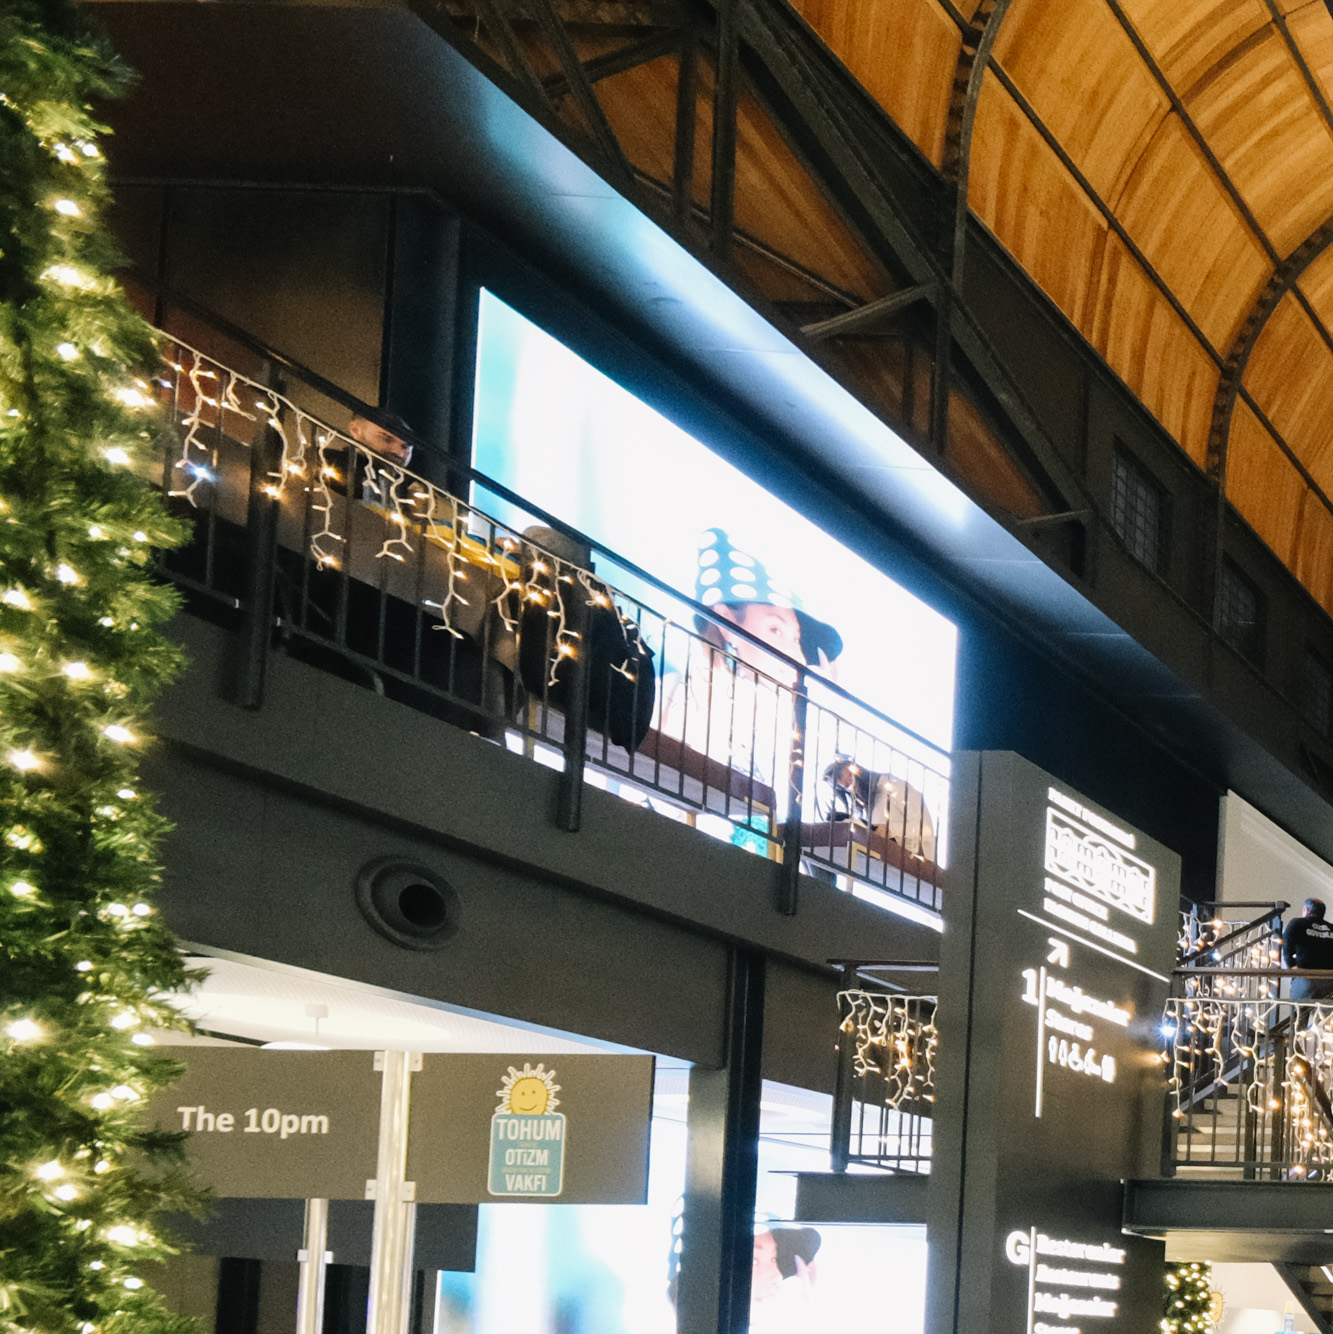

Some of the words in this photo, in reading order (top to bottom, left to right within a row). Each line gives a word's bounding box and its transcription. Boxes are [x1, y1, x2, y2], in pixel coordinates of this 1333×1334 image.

[1021, 969, 1039, 1006] 1
[176, 1105, 235, 1133] The
[243, 1107, 330, 1140] 10pm
[495, 1118, 562, 1141] TOHUM
[505, 1174, 547, 1192] VAKFI
[1005, 1230, 1031, 1265] G
